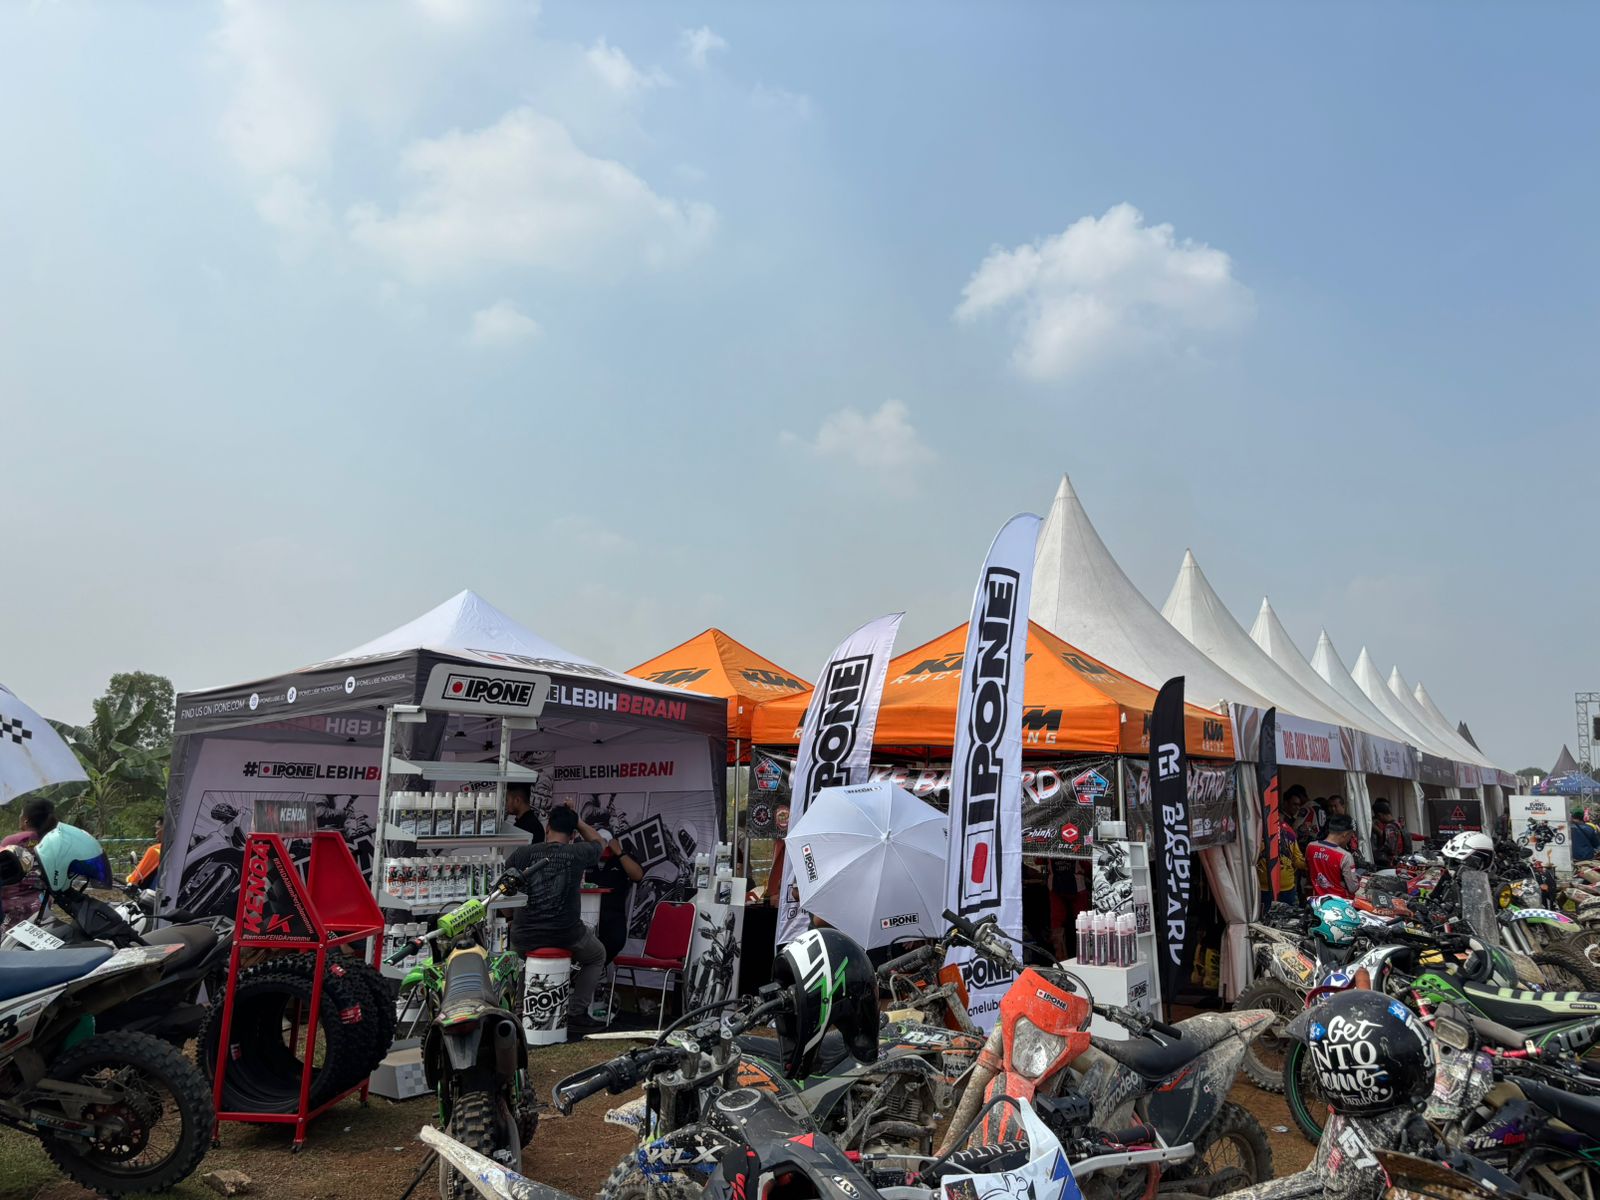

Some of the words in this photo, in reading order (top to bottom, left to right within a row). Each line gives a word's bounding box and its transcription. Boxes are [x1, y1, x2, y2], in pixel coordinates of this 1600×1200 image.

[465, 679, 531, 704] IPONE
[738, 668, 807, 692] KTM
[181, 708, 193, 719] FIND
[195, 706, 203, 717] US
[203, 704, 213, 715] ON
[968, 580, 1014, 827] IPONE
[808, 662, 867, 806] PONE
[1202, 717, 1224, 741] KTM
[280, 808, 307, 821] KENDA
[805, 853, 817, 881] IPONE
[245, 842, 272, 934] KENDA
[24, 924, 46, 942] 3896
[889, 915, 918, 927] IPONE
[524, 980, 571, 1014] IPONE
[1042, 991, 1068, 1011] IPONE
[1328, 1015, 1383, 1043] Get
[1341, 1086, 1380, 1106] trouble
[646, 1144, 726, 1164] KLX
[1338, 1126, 1379, 1170] 157
